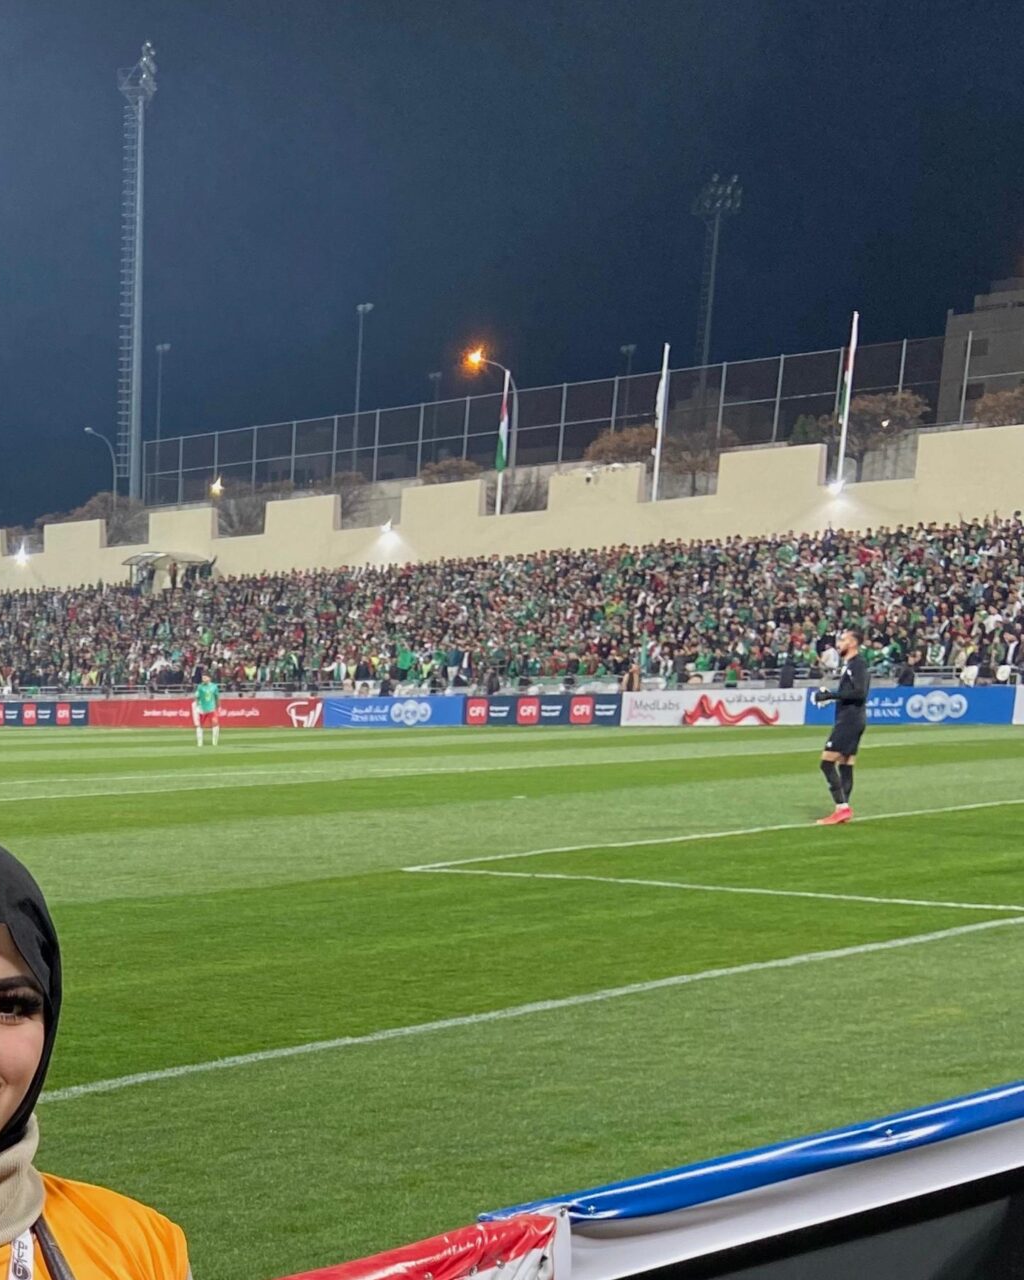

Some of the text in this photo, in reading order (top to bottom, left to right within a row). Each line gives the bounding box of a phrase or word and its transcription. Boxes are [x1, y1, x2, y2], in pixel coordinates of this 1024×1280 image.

[573, 704, 590, 716] CFI
[633, 700, 680, 711] MedLabs
[520, 706, 537, 717] CFI
[874, 709, 901, 718] BANK
